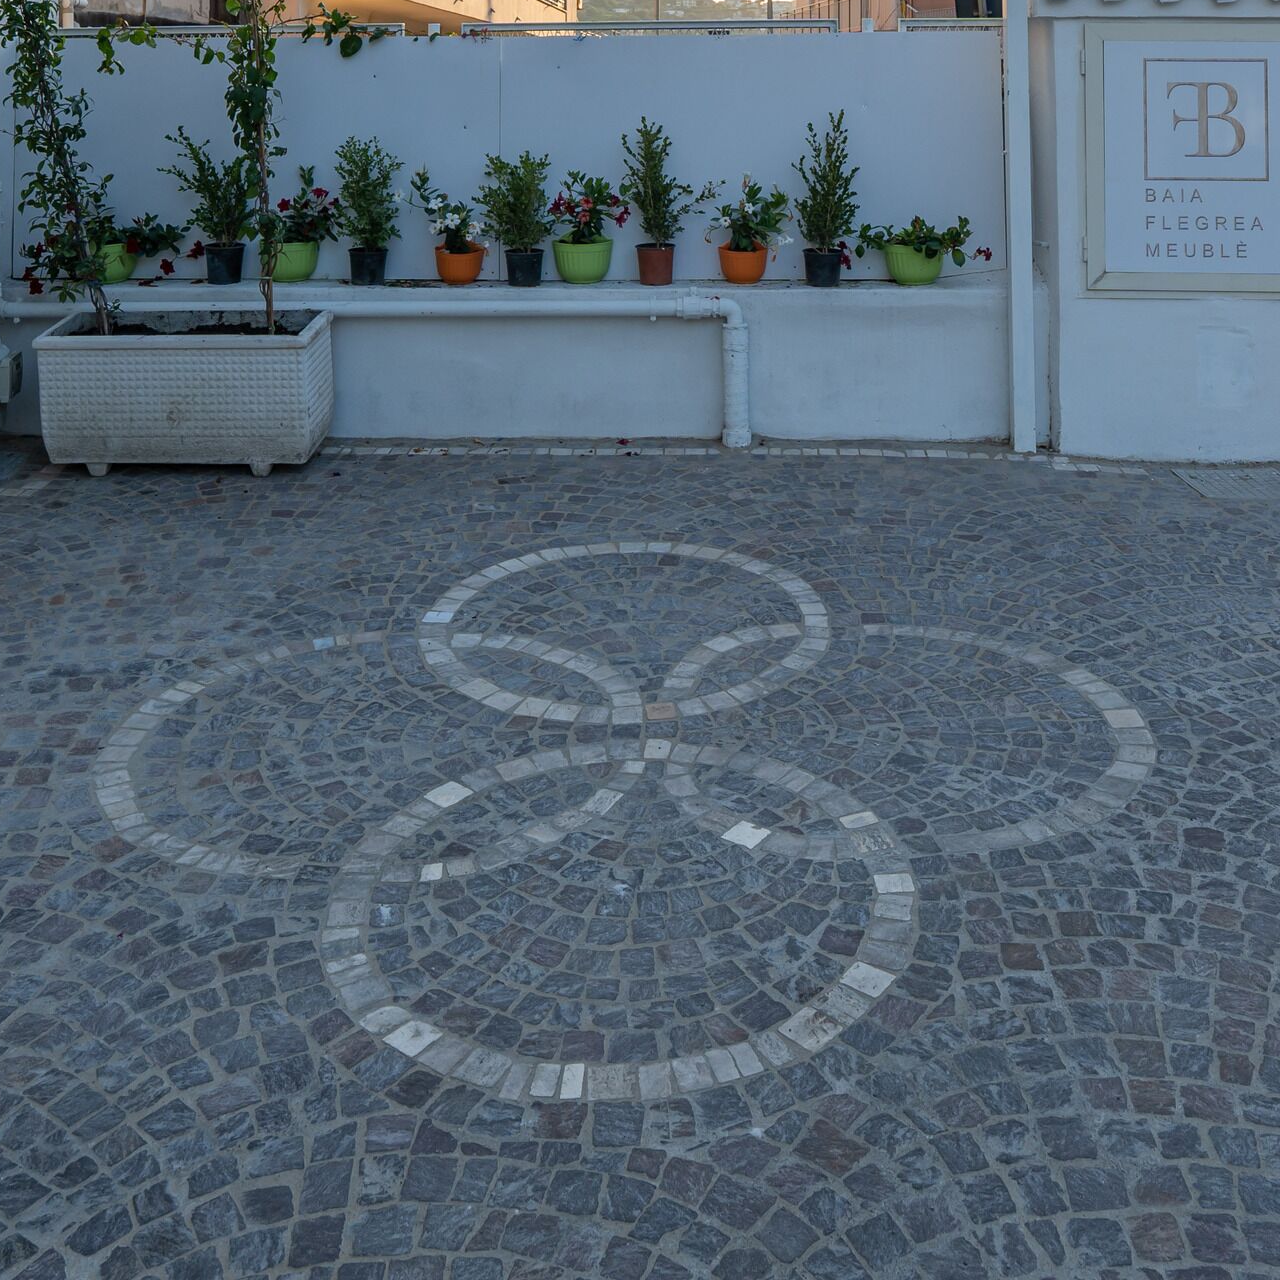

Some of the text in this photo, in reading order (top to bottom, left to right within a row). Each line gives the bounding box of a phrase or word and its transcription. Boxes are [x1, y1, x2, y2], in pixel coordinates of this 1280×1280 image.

[1145, 188, 1203, 203] BAIA
[1145, 216, 1264, 231] FLEGREA
[1145, 240, 1248, 259] MEUBLÈ
